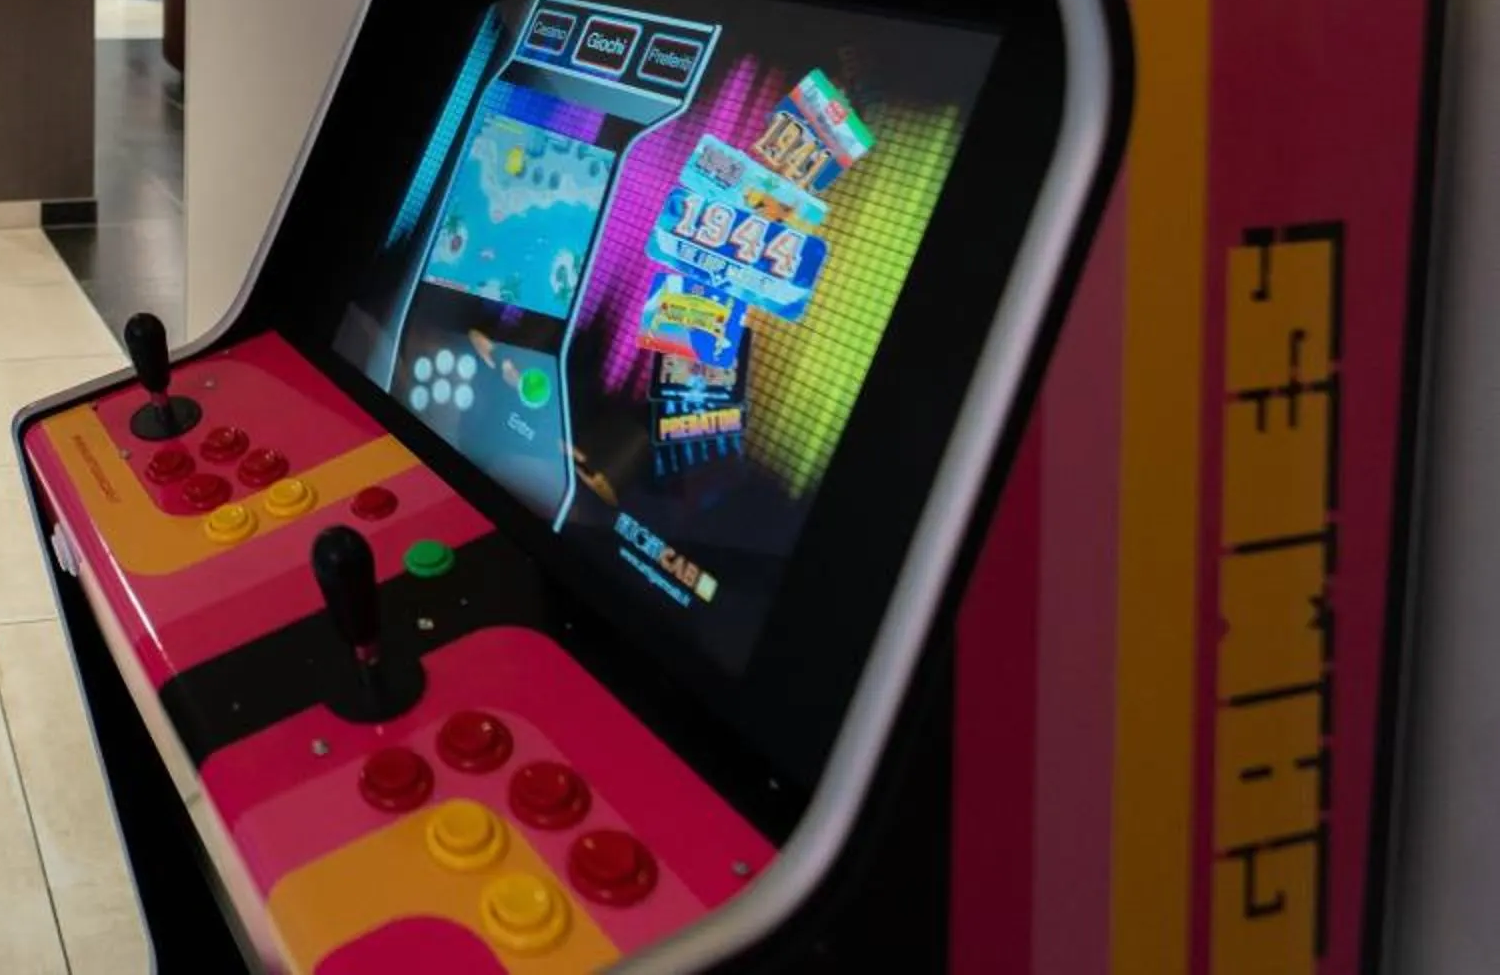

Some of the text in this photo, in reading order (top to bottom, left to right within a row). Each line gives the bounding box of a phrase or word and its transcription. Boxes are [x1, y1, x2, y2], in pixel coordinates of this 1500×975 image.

[586, 32, 627, 57] Giochi
[673, 193, 806, 279] 1944
[1211, 222, 1342, 974] GAMES
